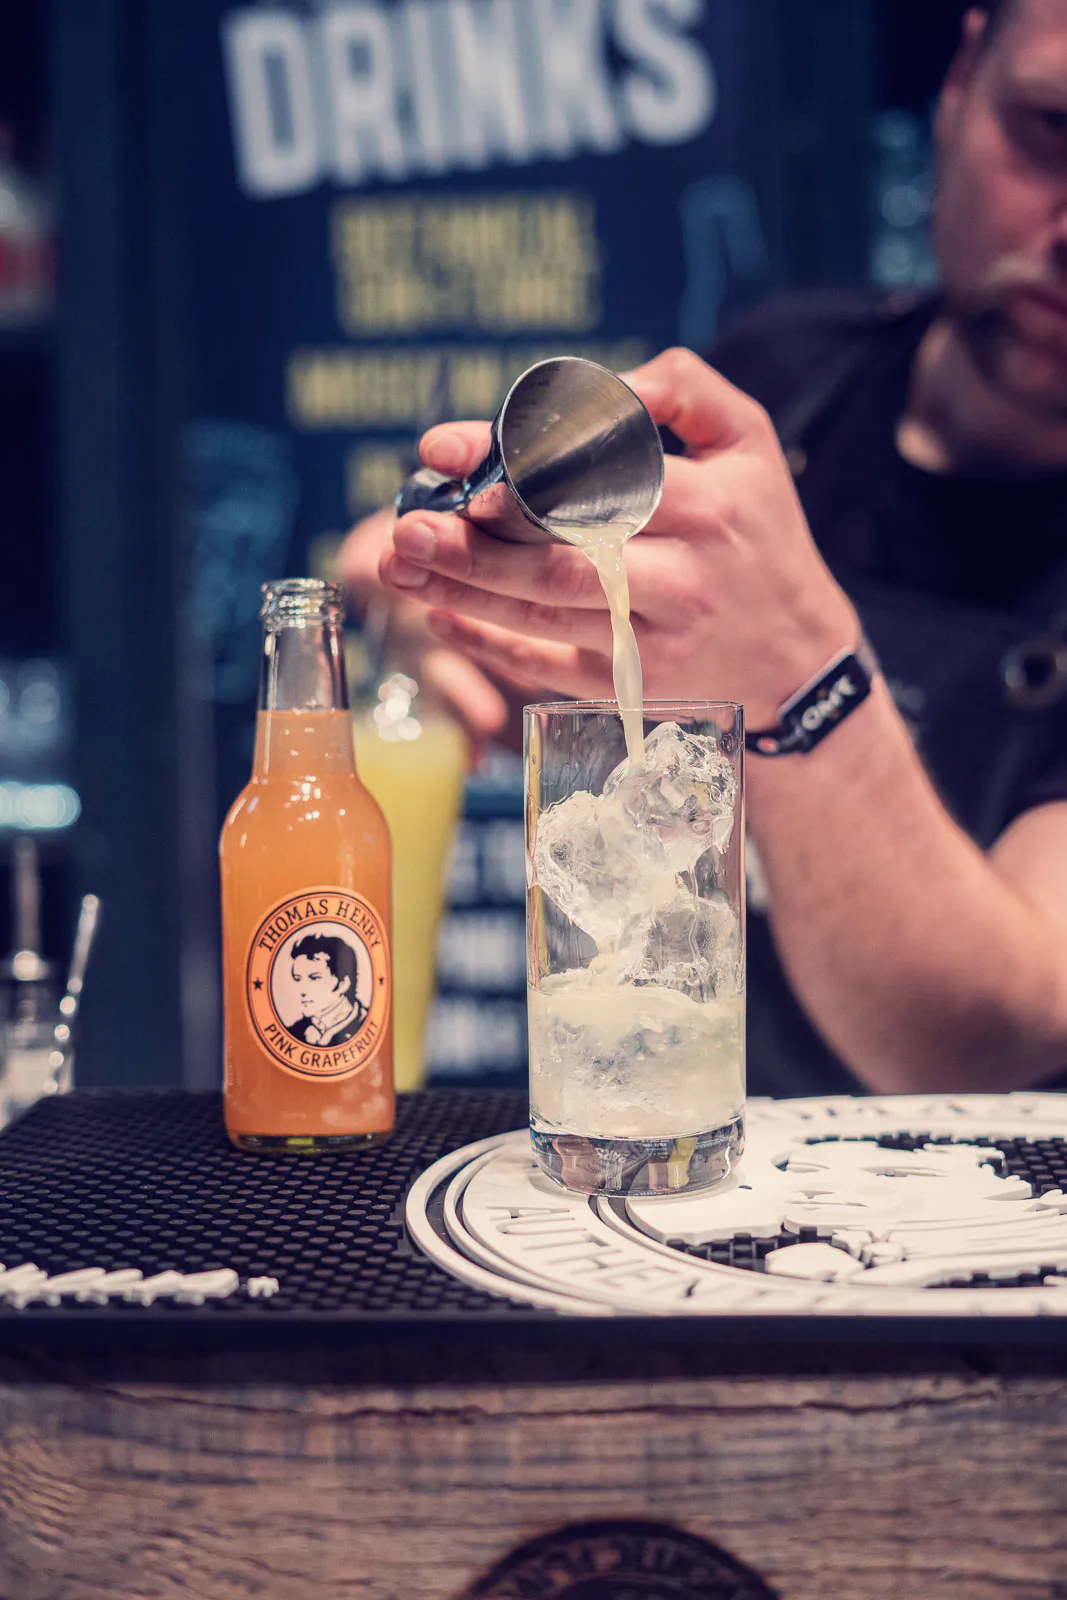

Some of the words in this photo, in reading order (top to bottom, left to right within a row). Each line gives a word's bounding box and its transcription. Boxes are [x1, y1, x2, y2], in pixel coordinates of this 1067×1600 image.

[224, 0, 715, 197] DRINKS
[259, 899, 329, 952] THOMAS
[335, 900, 381, 948] HENRY
[264, 1023, 298, 1059] PINK
[300, 1020, 379, 1067] GRAPEFRUIT
